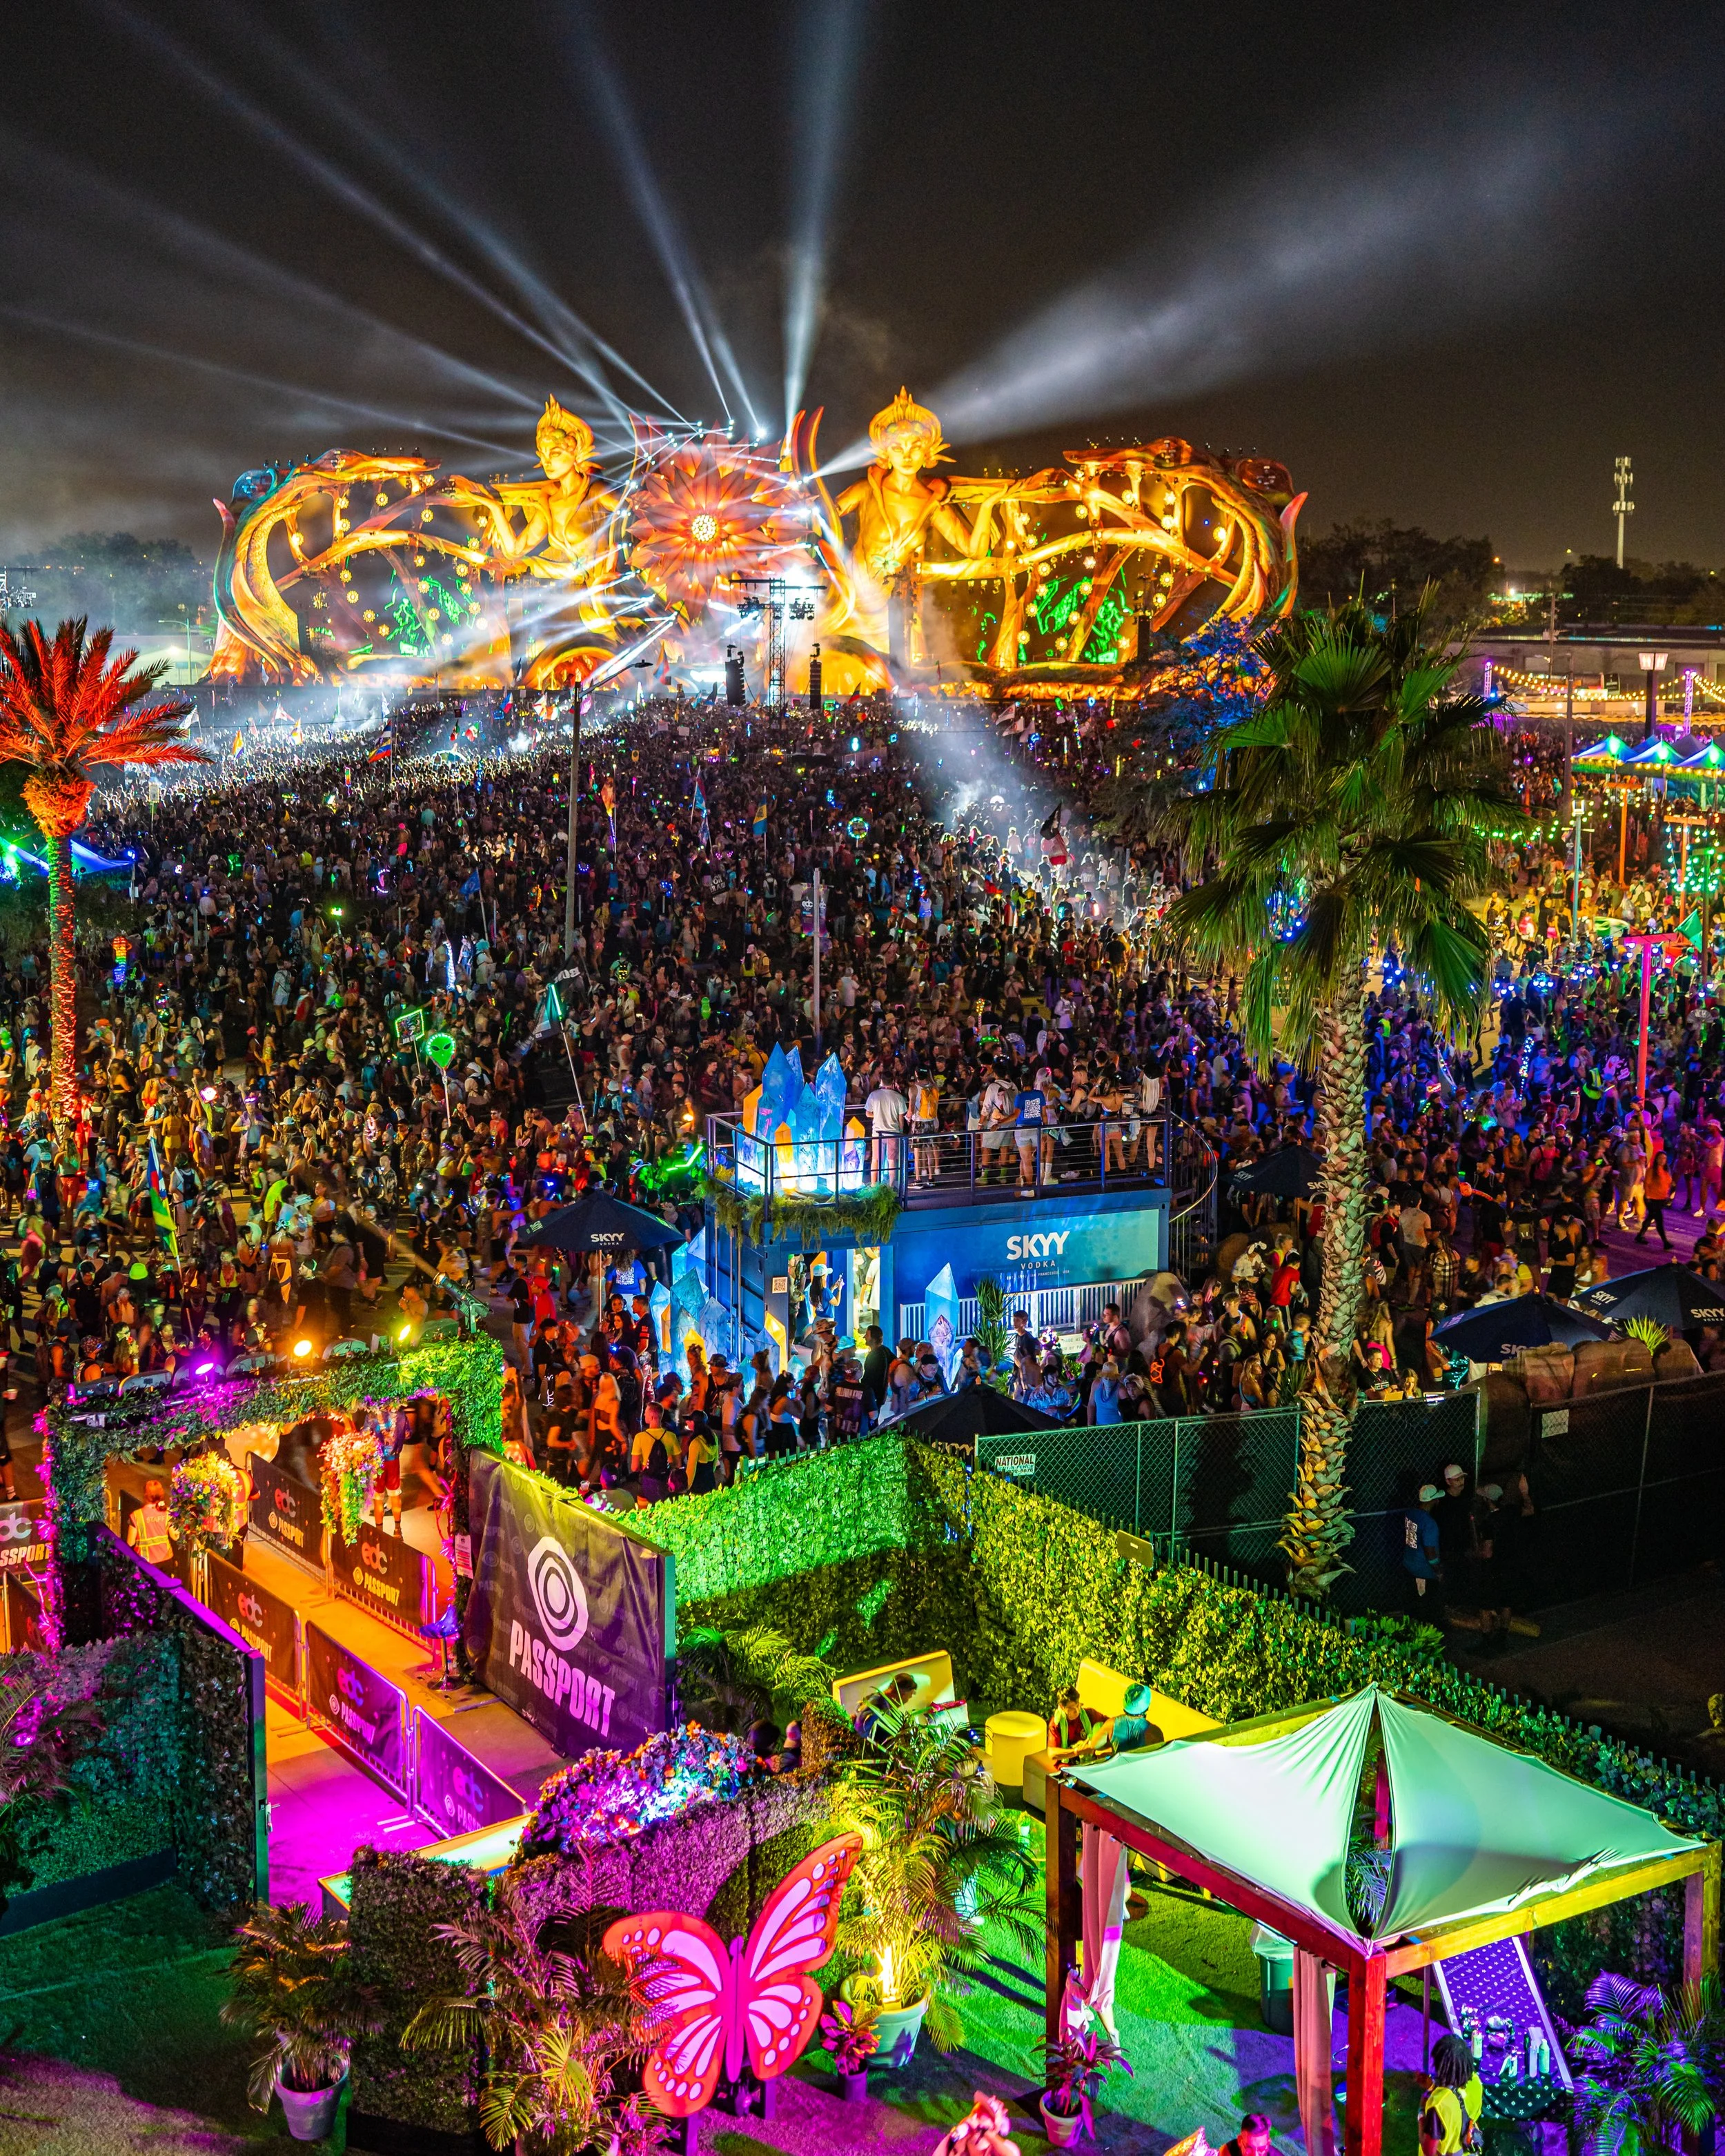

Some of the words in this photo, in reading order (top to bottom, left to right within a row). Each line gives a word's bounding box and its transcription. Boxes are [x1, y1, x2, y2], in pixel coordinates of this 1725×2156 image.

[1651, 956, 1660, 967] OP
[1307, 1181, 1328, 1189] SKY
[590, 1233, 625, 1243] SKYY
[1006, 1231, 1070, 1260] SKYY
[1021, 1260, 1056, 1270] VODKA
[1591, 1291, 1618, 1304] SKYY
[1690, 1308, 1725, 1318] SKYY
[996, 1455, 1034, 1466] NATIONAL
[275, 1488, 297, 1518] edc
[0, 1511, 32, 1542] dc
[278, 1516, 304, 1548] PASSPORT
[362, 1542, 388, 1574] edc
[364, 1572, 400, 1607] PASSPORT
[237, 1592, 264, 1628] edc
[337, 1667, 364, 1708] edc
[509, 1619, 615, 1737] PASSPORT
[341, 1701, 376, 1745] PASSPORT
[453, 1766, 484, 1812] edc
